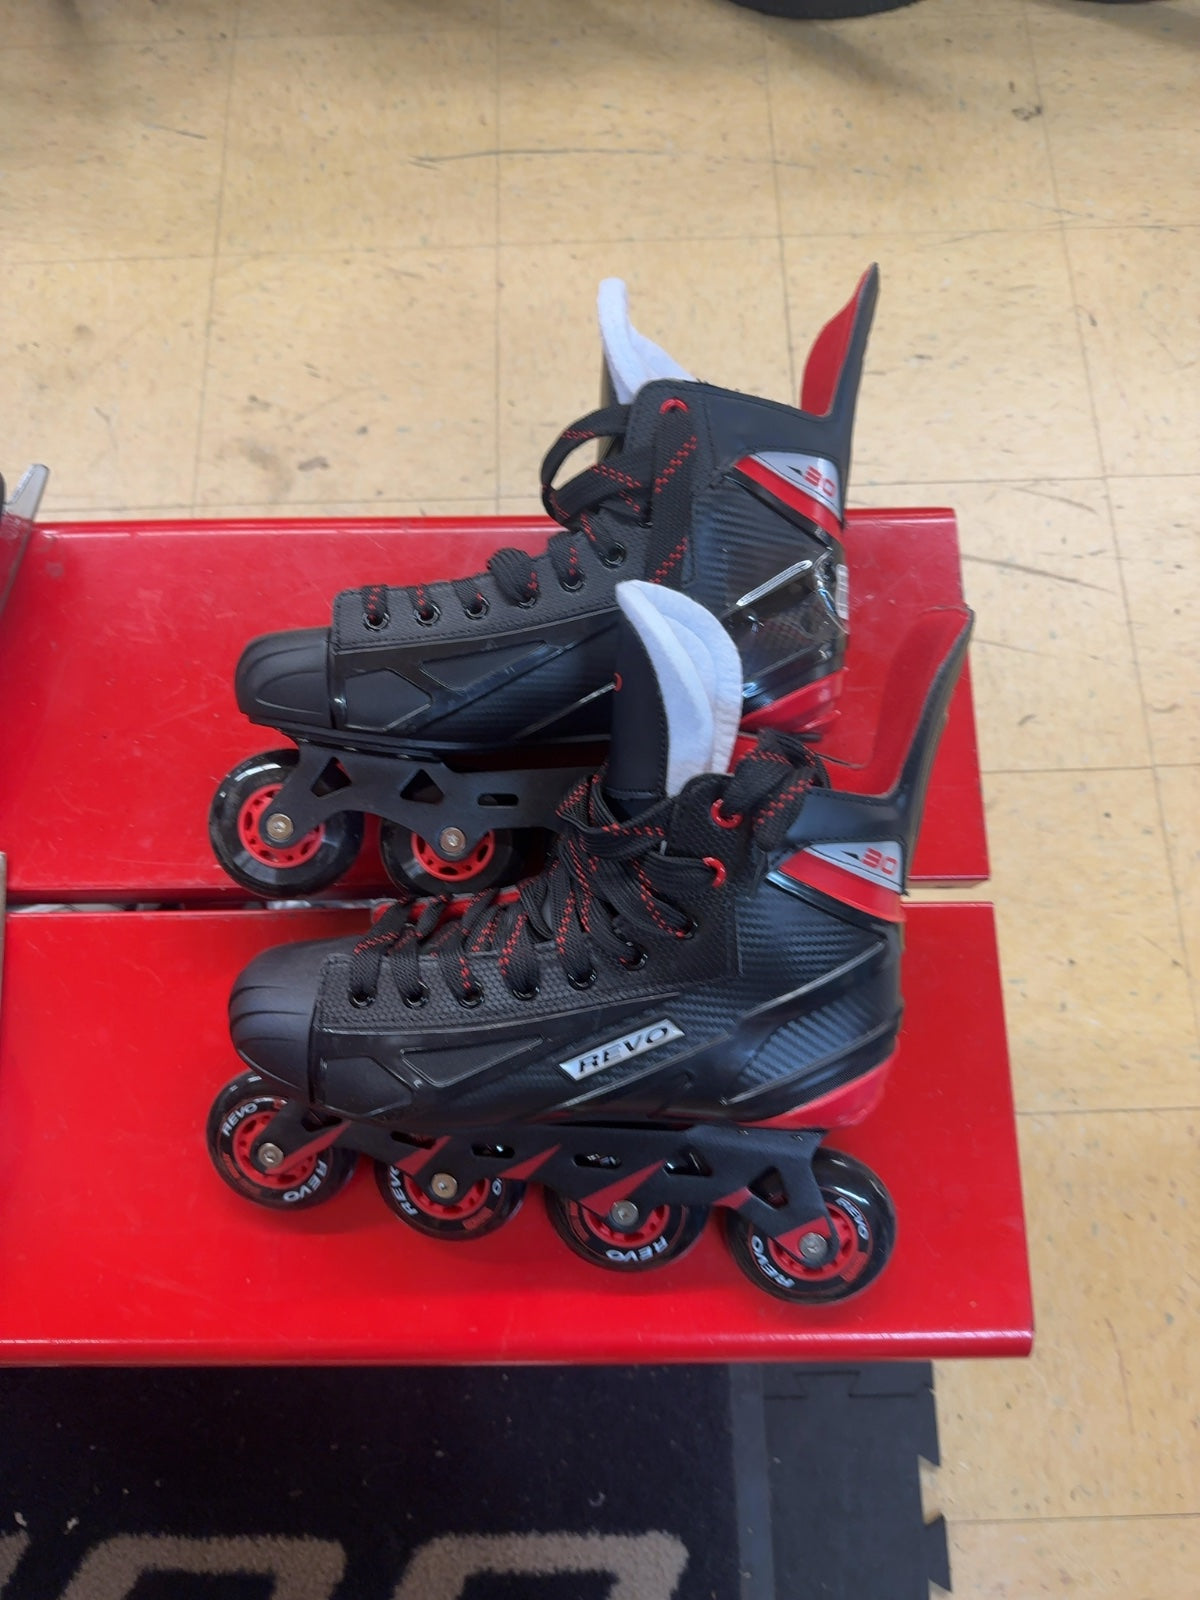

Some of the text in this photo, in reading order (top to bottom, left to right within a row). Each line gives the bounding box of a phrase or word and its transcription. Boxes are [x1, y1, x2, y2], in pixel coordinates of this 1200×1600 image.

[579, 1025, 668, 1073] REVO
[222, 1102, 258, 1137] REVO
[283, 1159, 328, 1202] REVO
[835, 1197, 870, 1240] REVO
[605, 1235, 669, 1263] REVO
[752, 1235, 795, 1288] REVO
